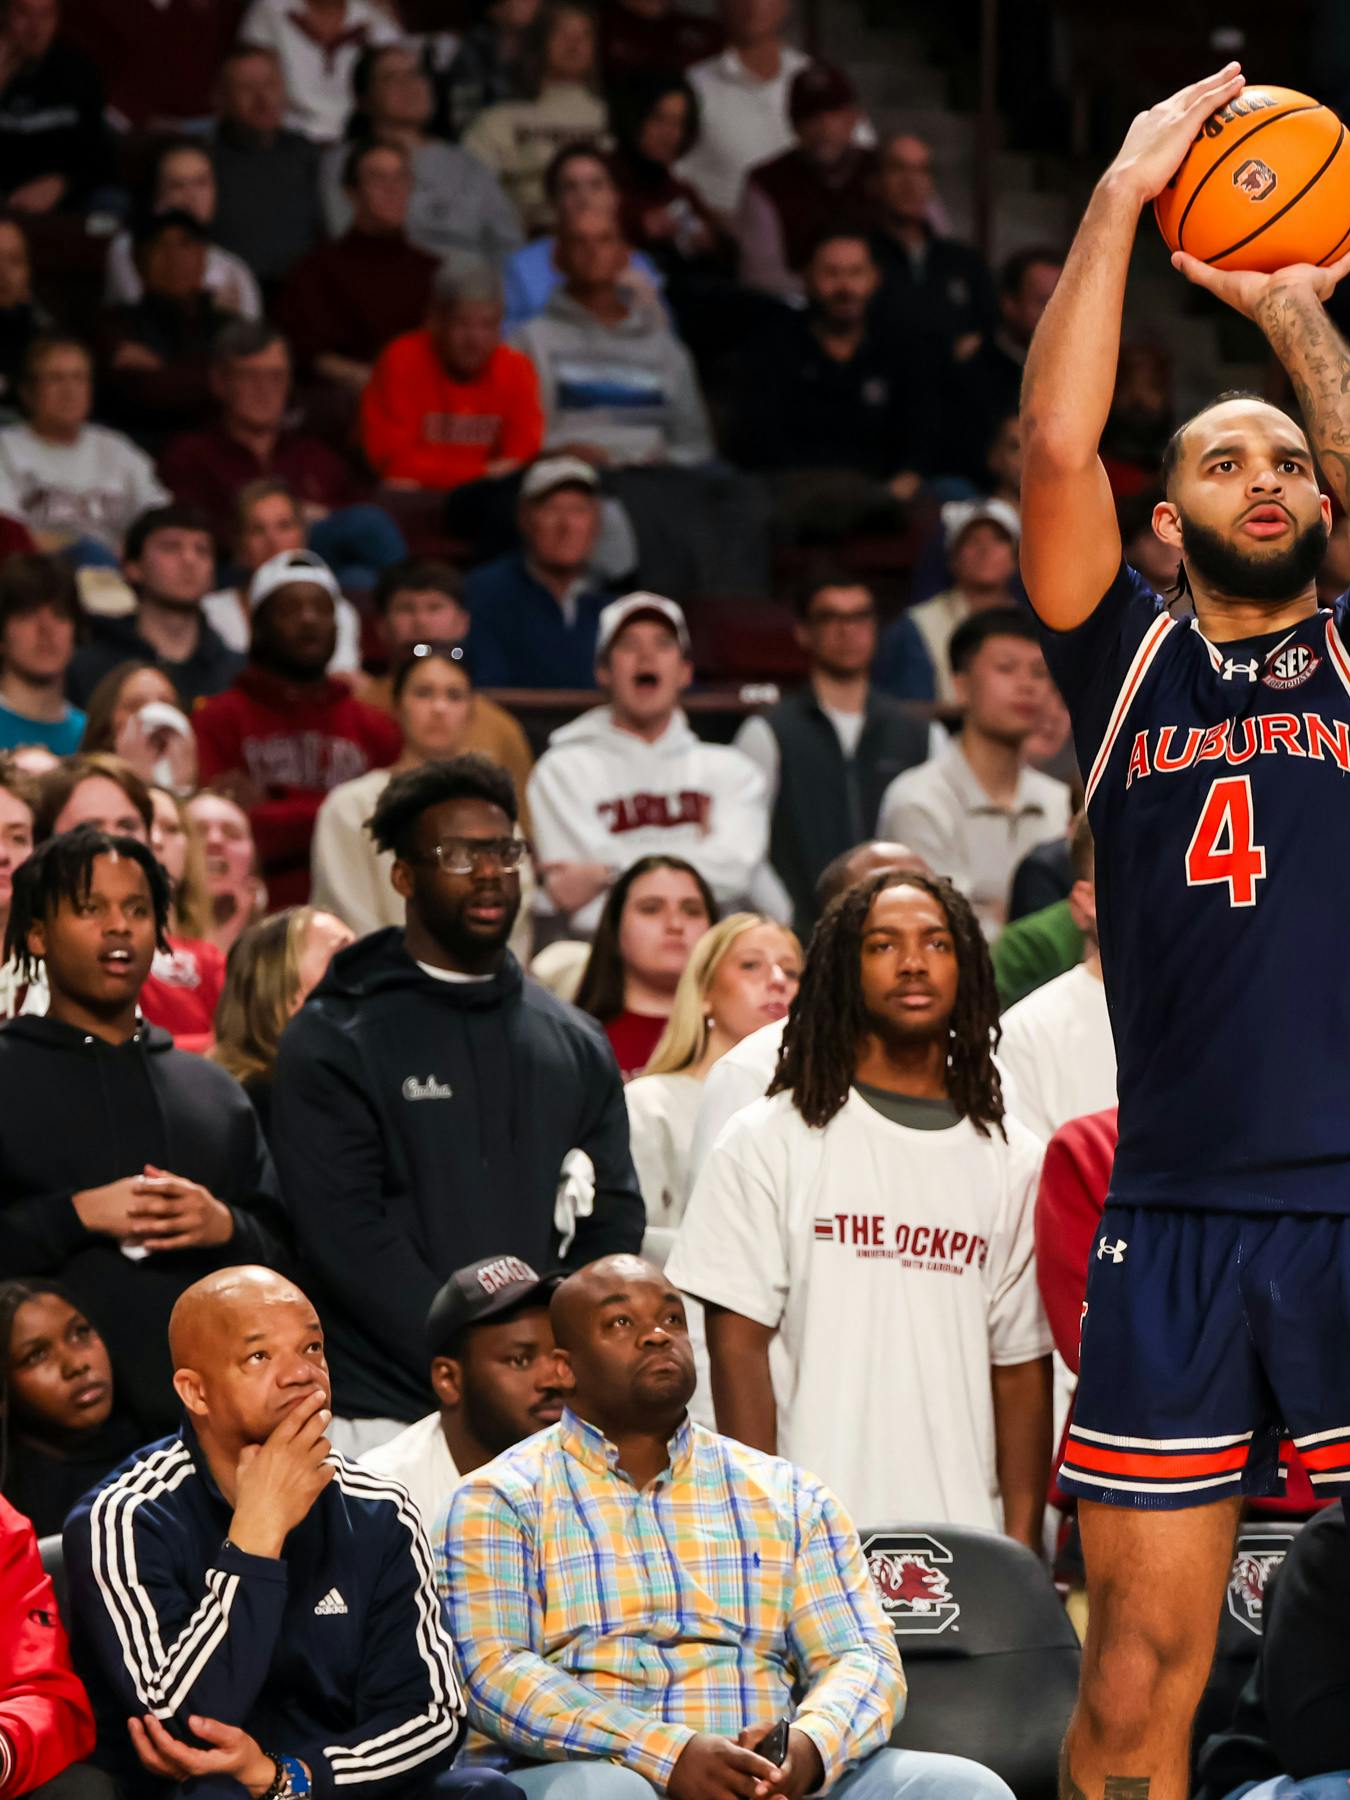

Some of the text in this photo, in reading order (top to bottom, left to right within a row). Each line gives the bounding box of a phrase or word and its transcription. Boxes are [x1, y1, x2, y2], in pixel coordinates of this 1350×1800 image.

[1274, 646, 1309, 679] SEC
[1185, 774, 1267, 908] 4
[835, 1214, 885, 1245] THE
